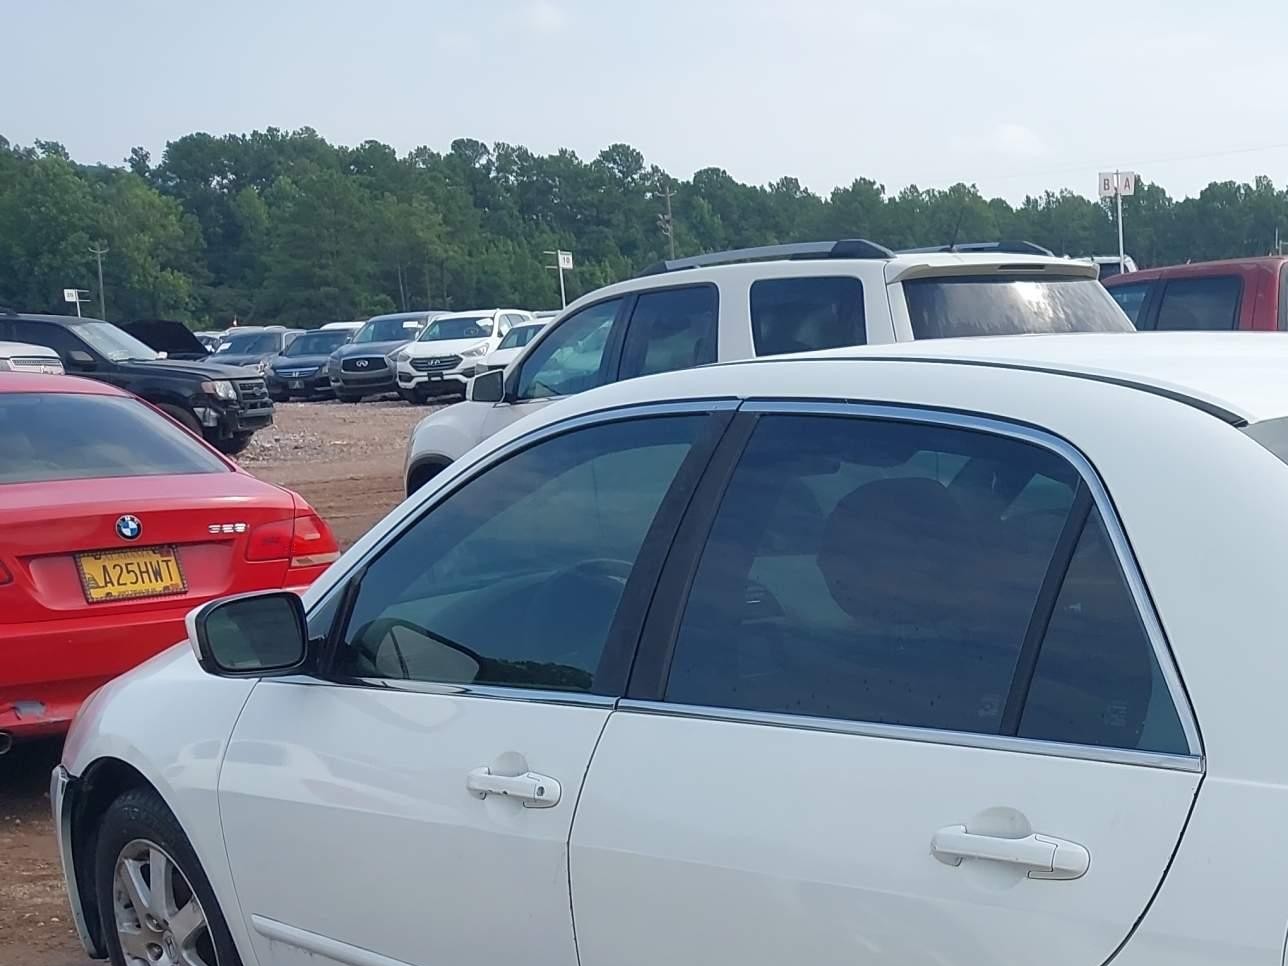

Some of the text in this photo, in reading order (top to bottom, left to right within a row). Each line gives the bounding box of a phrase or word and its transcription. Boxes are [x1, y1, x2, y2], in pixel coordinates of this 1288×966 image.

[1103, 178, 1110, 191] B
[1123, 177, 1131, 190] A
[102, 559, 173, 588] A25HWT
